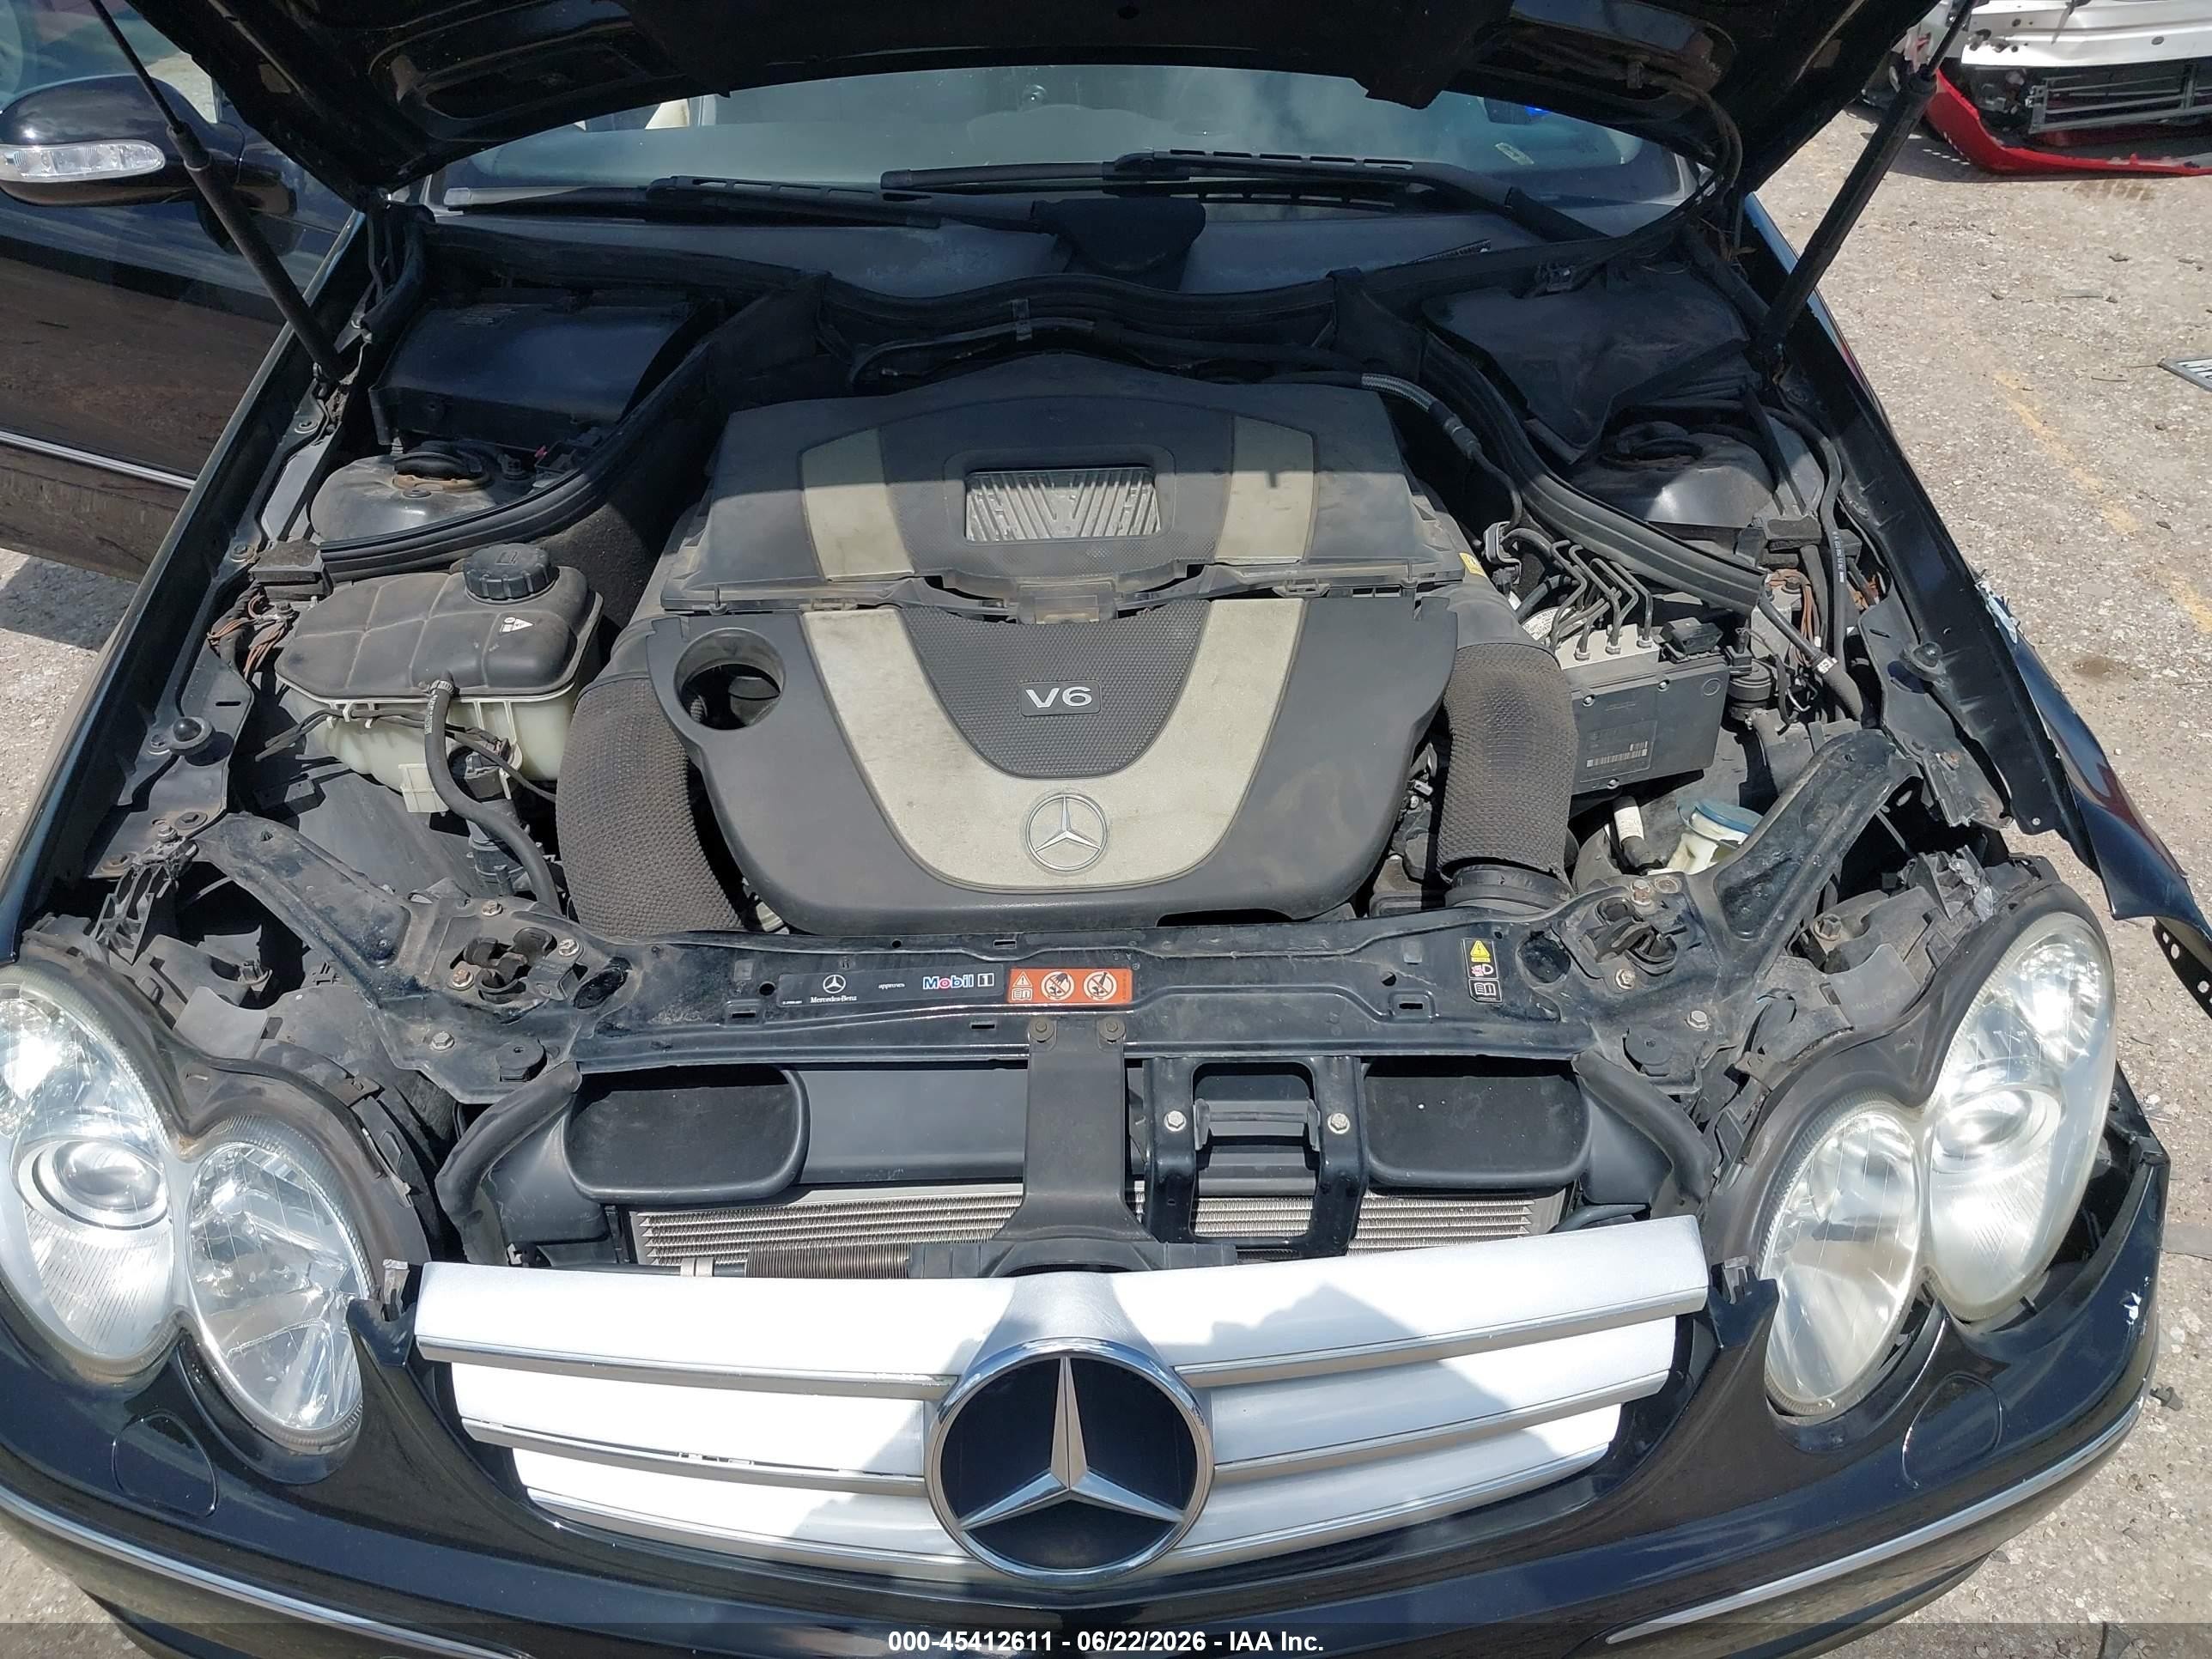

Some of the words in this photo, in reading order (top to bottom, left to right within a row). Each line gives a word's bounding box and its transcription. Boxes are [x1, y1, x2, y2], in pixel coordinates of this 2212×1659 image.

[1025, 686, 1092, 708] V6
[922, 974, 975, 990] Mobil
[810, 995, 858, 1004] Mercedes-Benz
